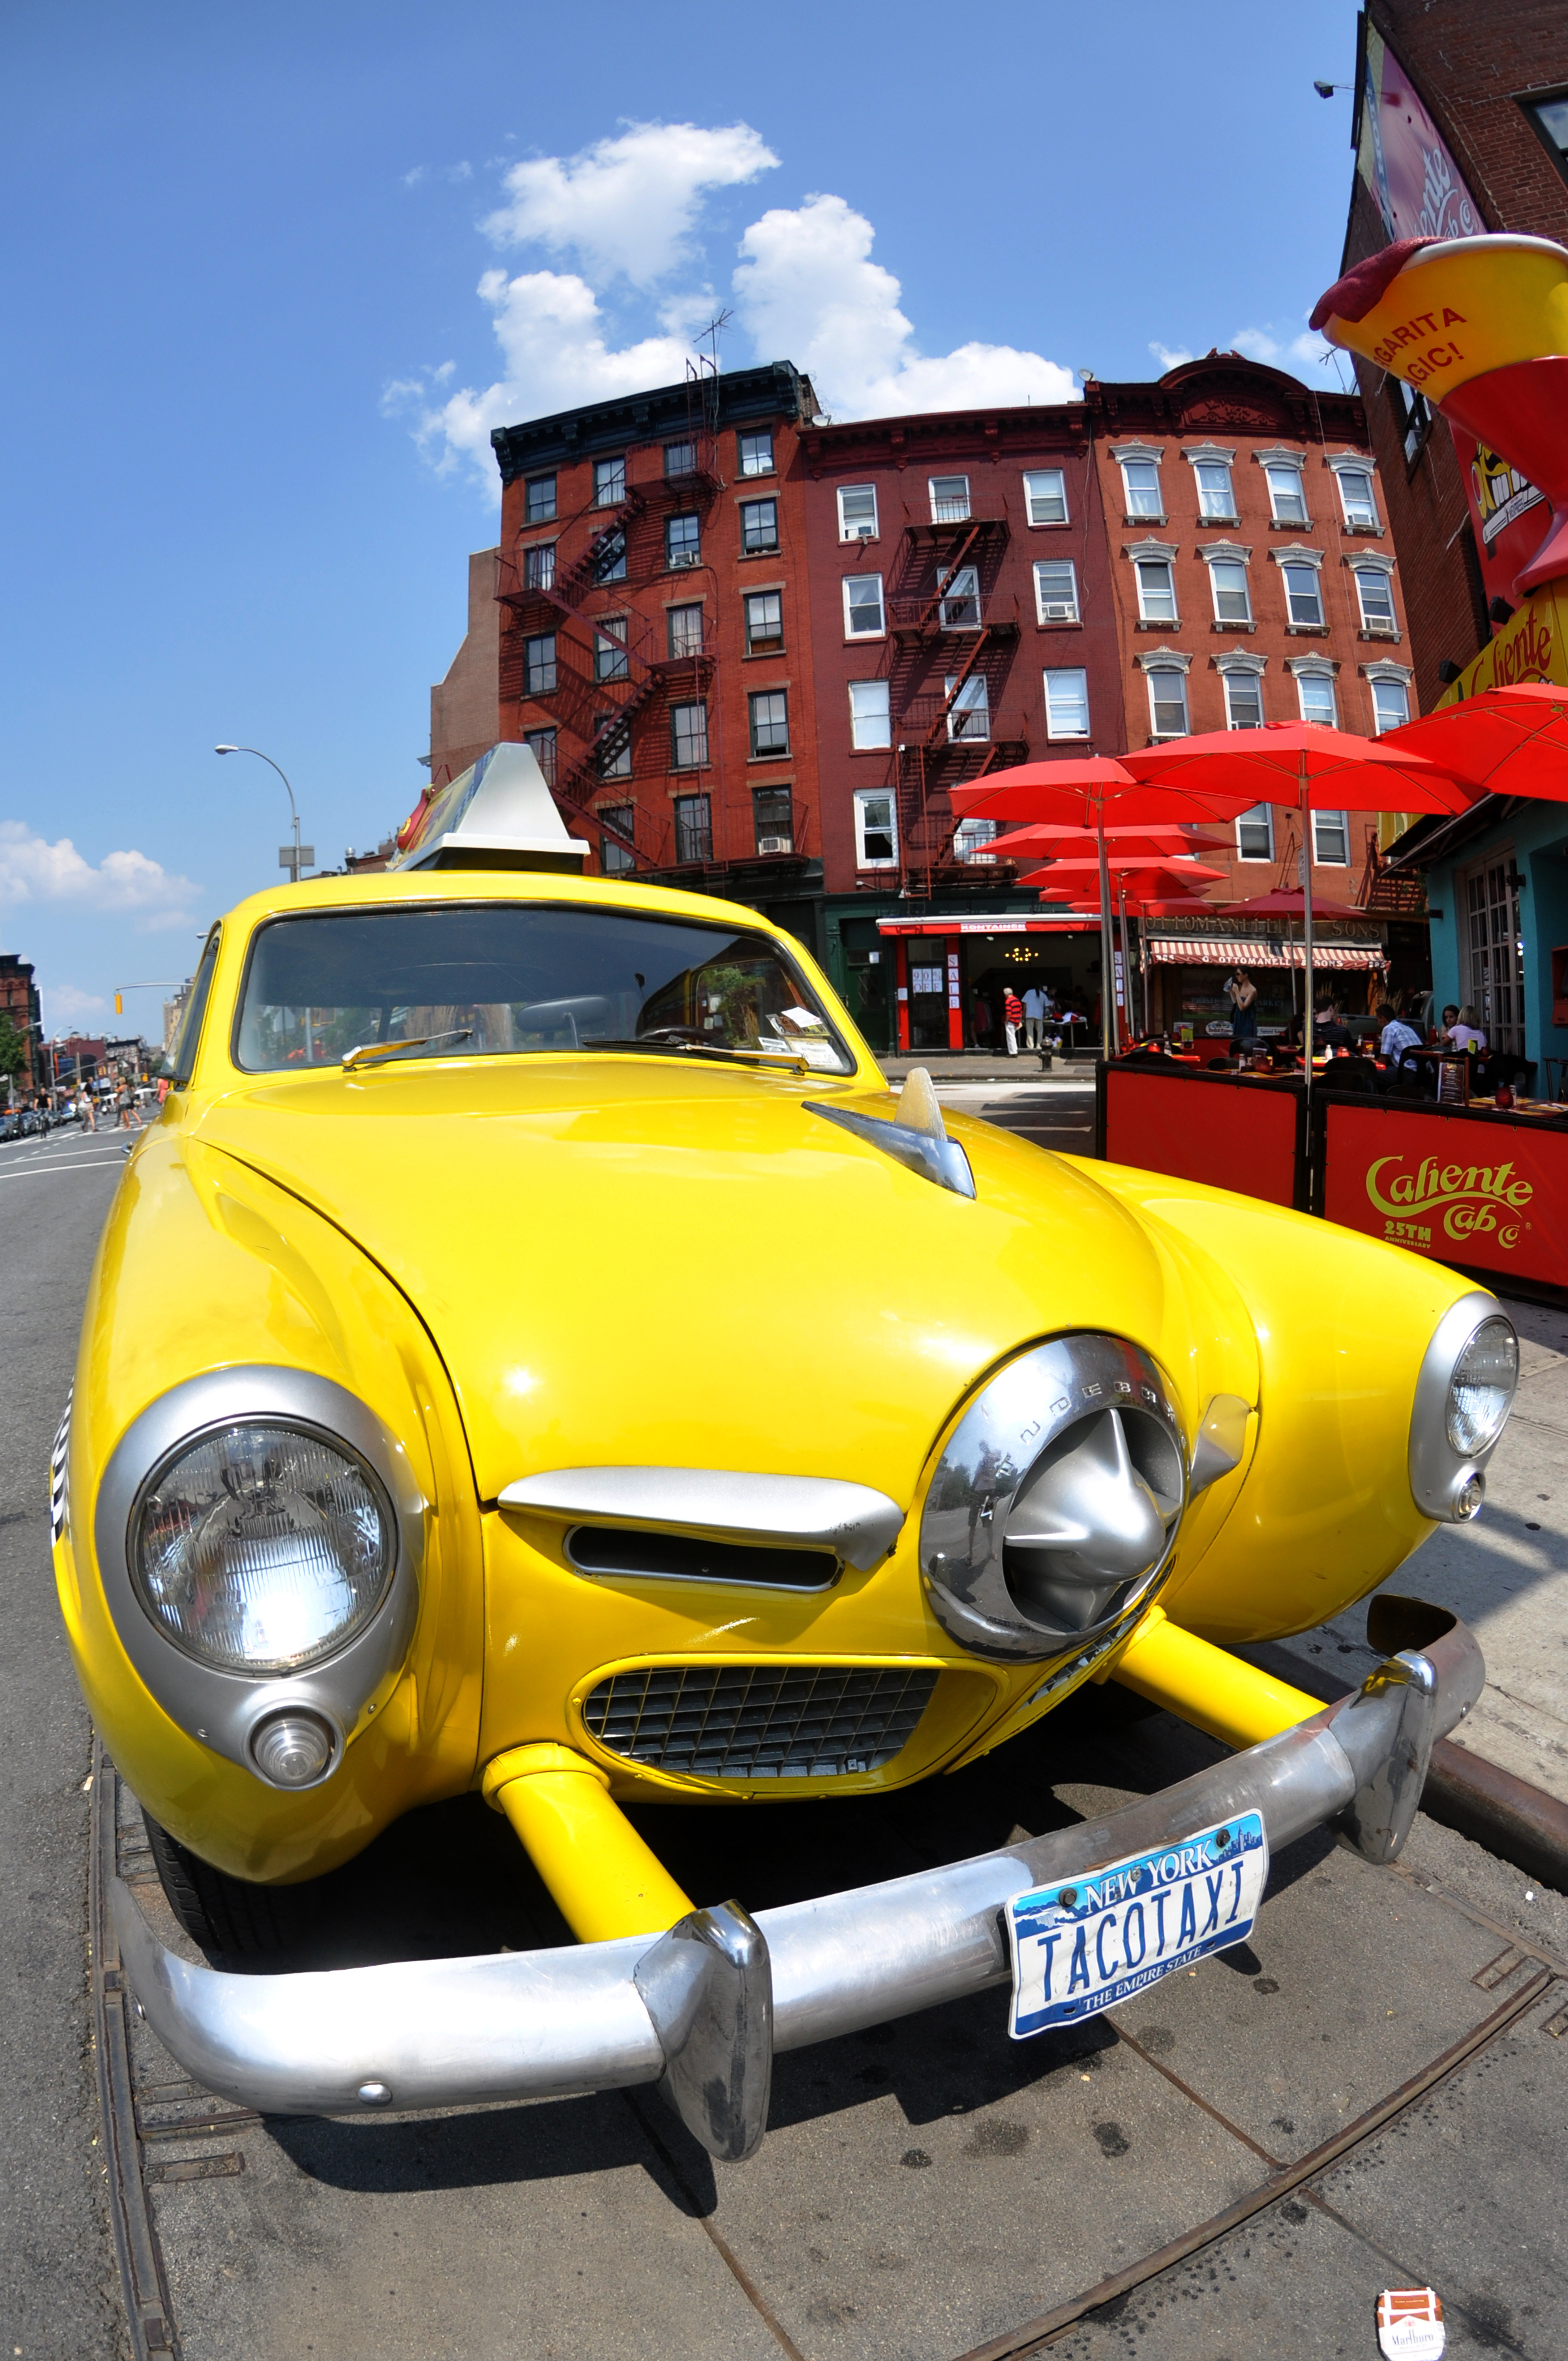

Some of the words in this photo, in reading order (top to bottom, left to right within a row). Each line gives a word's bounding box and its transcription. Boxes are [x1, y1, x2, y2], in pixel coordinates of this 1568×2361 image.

[1404, 342, 1464, 390] AGIC!
[1331, 920, 1380, 938] SONS
[913, 971, 942, 981] 90%
[1218, 956, 1291, 966] OTTOMANELL
[914, 983, 941, 992] OFF
[949, 957, 957, 1008] SALE
[1366, 1155, 1533, 1218] Caliente
[1384, 1220, 1431, 1242] 25TH
[1443, 1205, 1496, 1240] Cab
[1385, 1236, 1431, 1248] ANNIVERSARY
[1083, 1865, 1141, 1916] NEW
[1146, 1840, 1213, 1888] YORK
[1037, 1860, 1244, 2002] TACOTAXI
[1083, 1988, 1112, 2012] THE
[1115, 1962, 1164, 1996] EMPIRE
[1165, 1946, 1202, 1973] STATE
